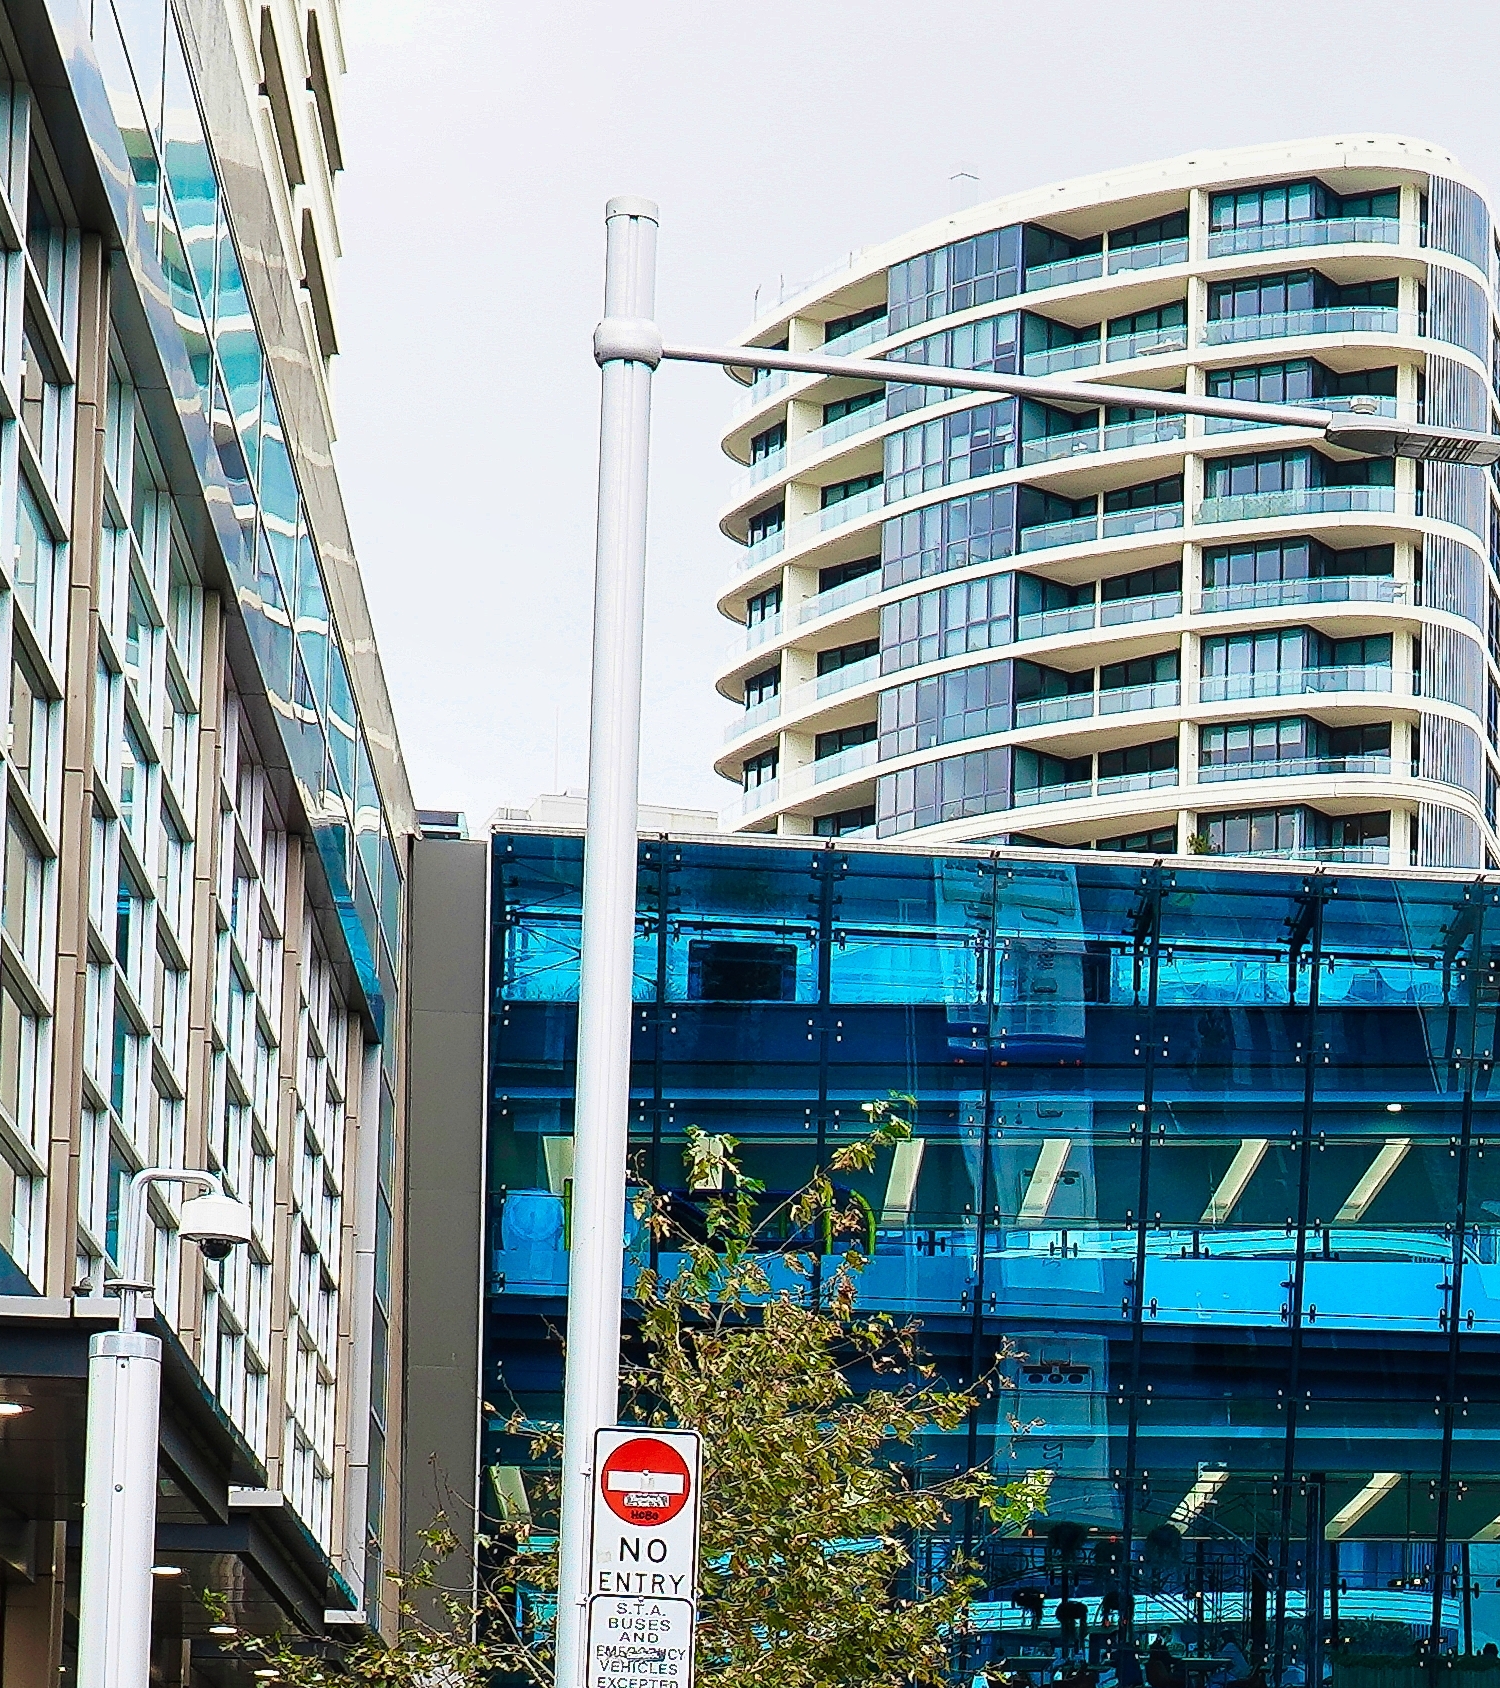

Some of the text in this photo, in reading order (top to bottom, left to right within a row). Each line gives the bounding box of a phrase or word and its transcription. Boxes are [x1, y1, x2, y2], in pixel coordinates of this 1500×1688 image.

[619, 1537, 668, 1564] NO
[599, 1572, 686, 1595] ENTRY
[616, 1602, 667, 1617] S.T.A.
[608, 1617, 671, 1632] BUSES
[619, 1631, 659, 1643] AND
[600, 1659, 678, 1676] VEHICLES
